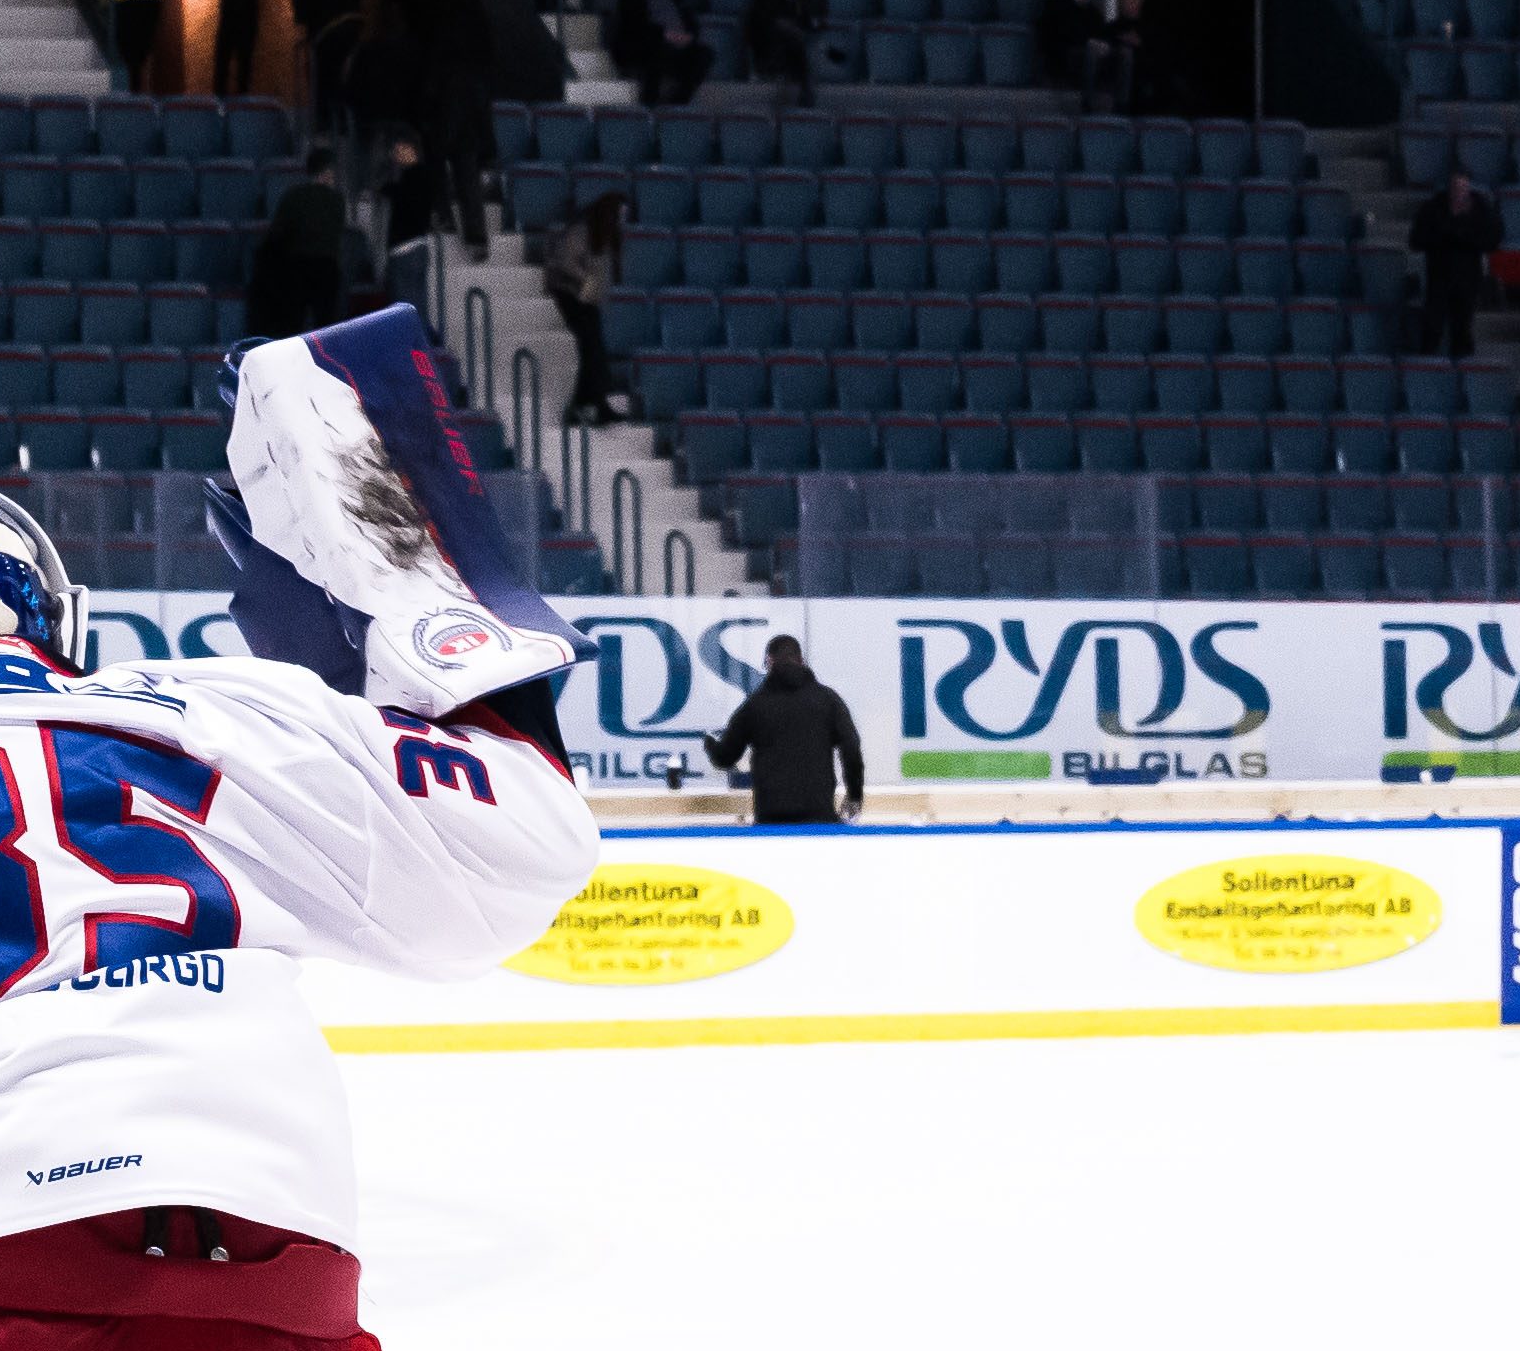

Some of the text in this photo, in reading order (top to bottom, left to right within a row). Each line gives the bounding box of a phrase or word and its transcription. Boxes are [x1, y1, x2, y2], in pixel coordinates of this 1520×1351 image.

[897, 618, 1271, 741] RYDS
[566, 882, 700, 904] ollentuna
[1222, 872, 1356, 894] Sollentuna
[730, 908, 761, 927] AB
[1384, 898, 1412, 916] AB
[47, 1154, 143, 1184] BAUER
